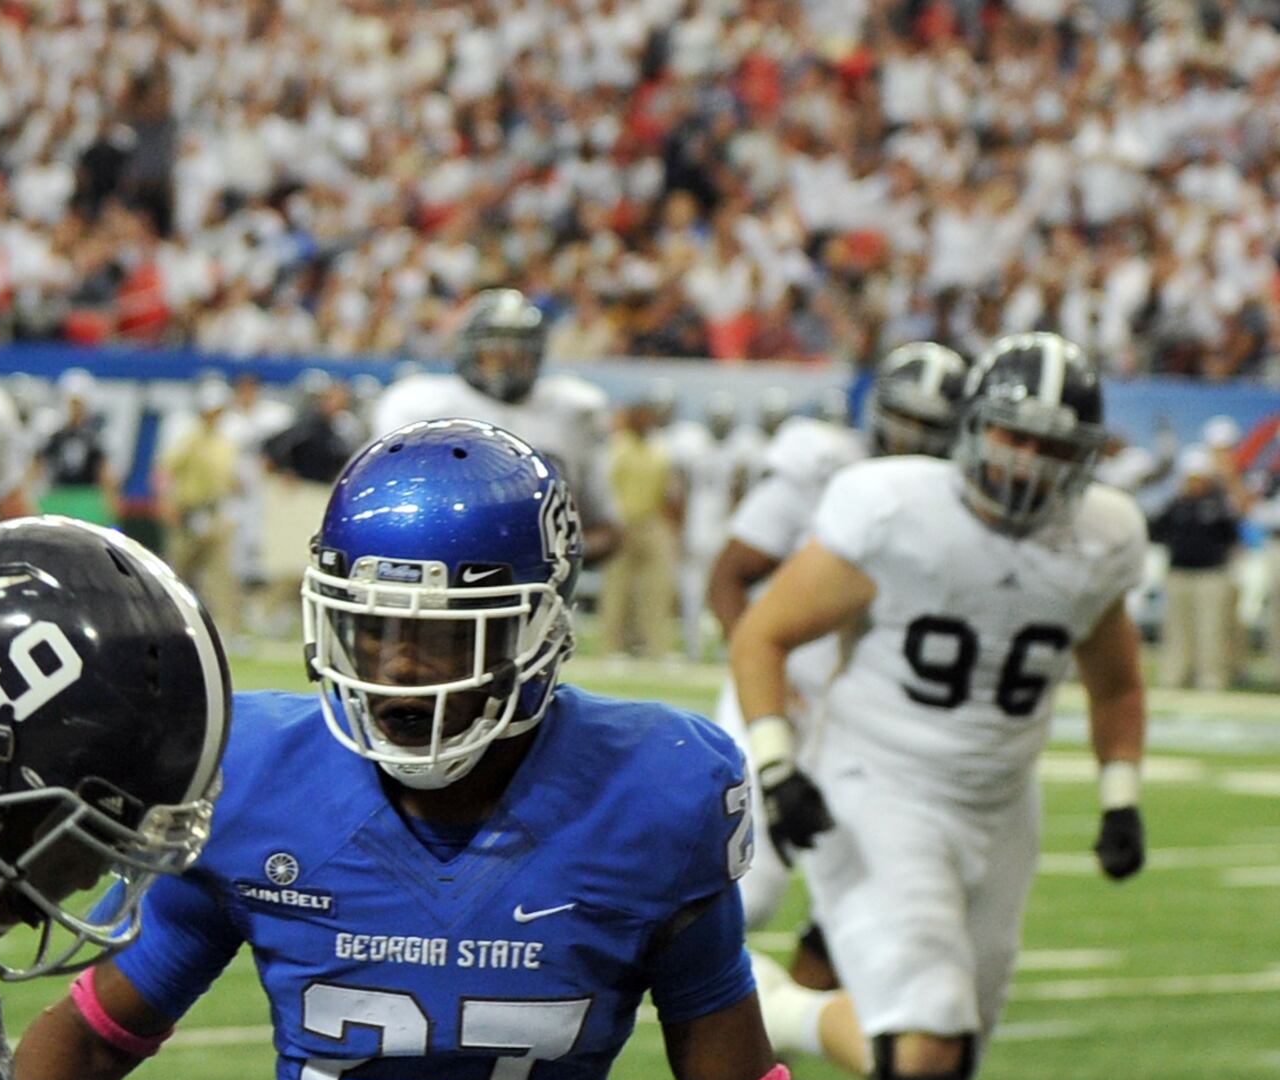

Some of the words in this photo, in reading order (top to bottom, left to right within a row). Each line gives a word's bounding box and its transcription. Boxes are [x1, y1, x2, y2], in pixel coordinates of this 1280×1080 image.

[901, 614, 1072, 717] 96
[335, 932, 448, 967] GEORGIA
[456, 939, 544, 969] STATE
